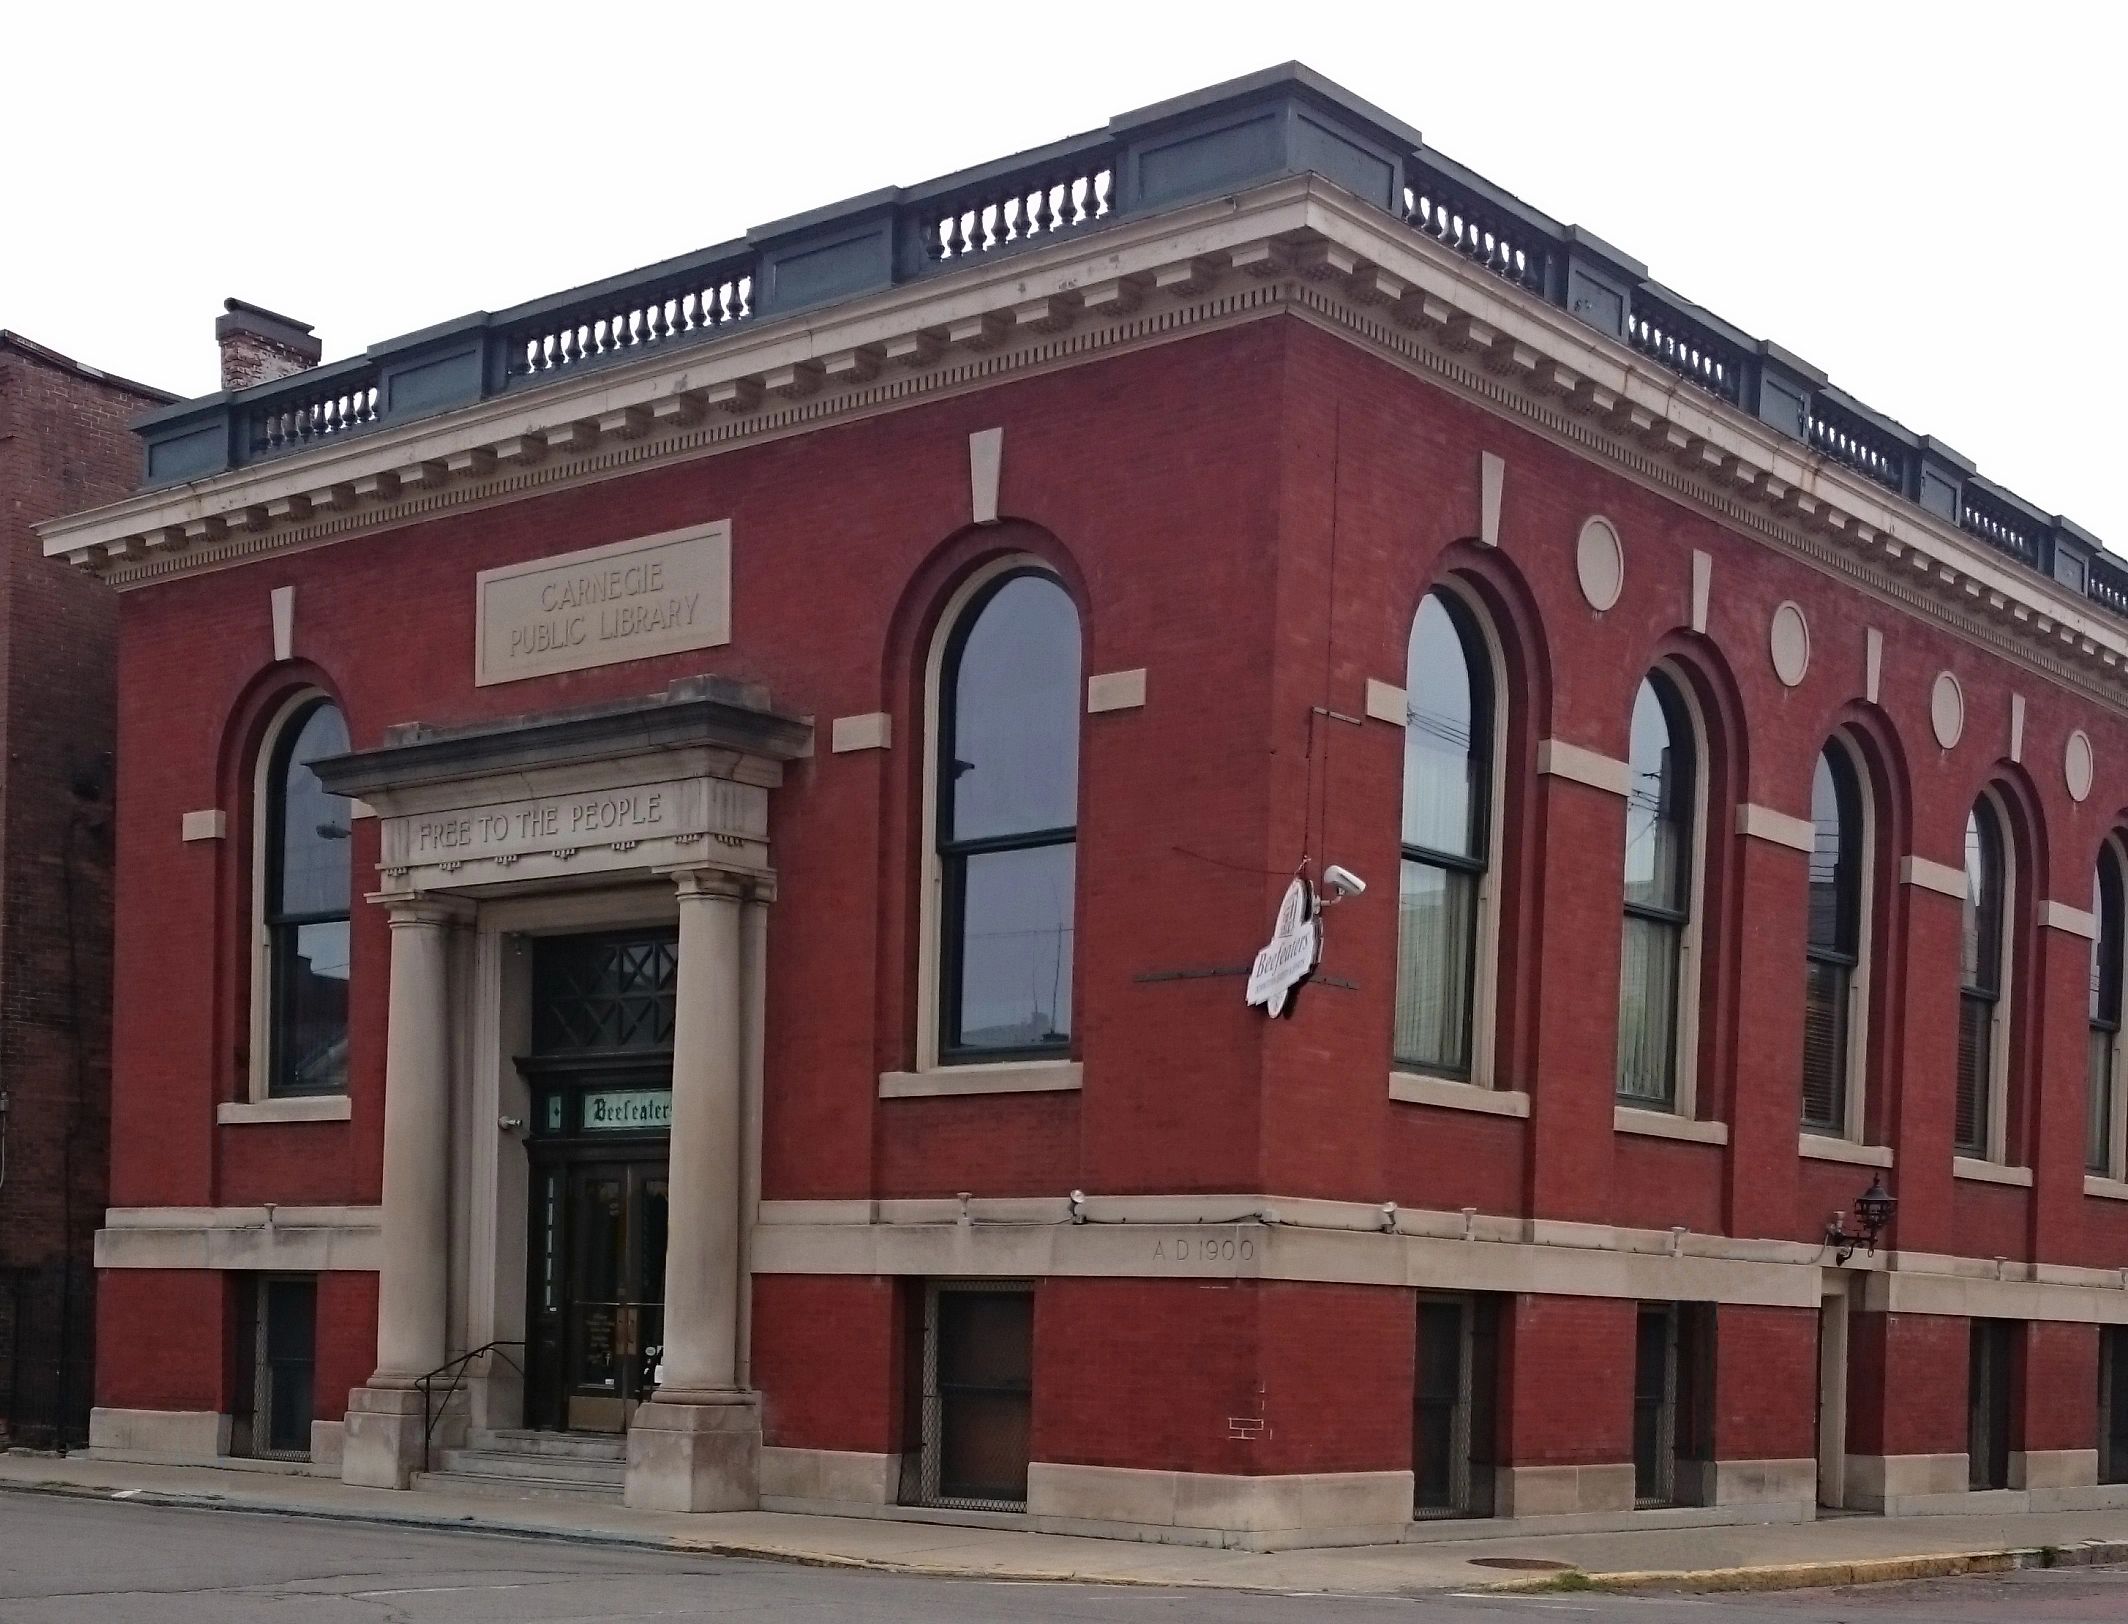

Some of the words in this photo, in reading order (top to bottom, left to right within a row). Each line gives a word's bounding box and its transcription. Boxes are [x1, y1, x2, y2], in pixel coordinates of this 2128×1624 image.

[541, 563, 663, 612] CARNEGIE
[510, 617, 586, 656] PUBLIC
[600, 593, 699, 641] LIBRARY
[419, 820, 471, 850] FREE
[479, 815, 508, 842] TO
[515, 807, 557, 837] THE
[570, 793, 662, 832] PEOPLE
[594, 1098, 672, 1121] Beefeater
[1200, 1239, 1254, 1261] 1900
